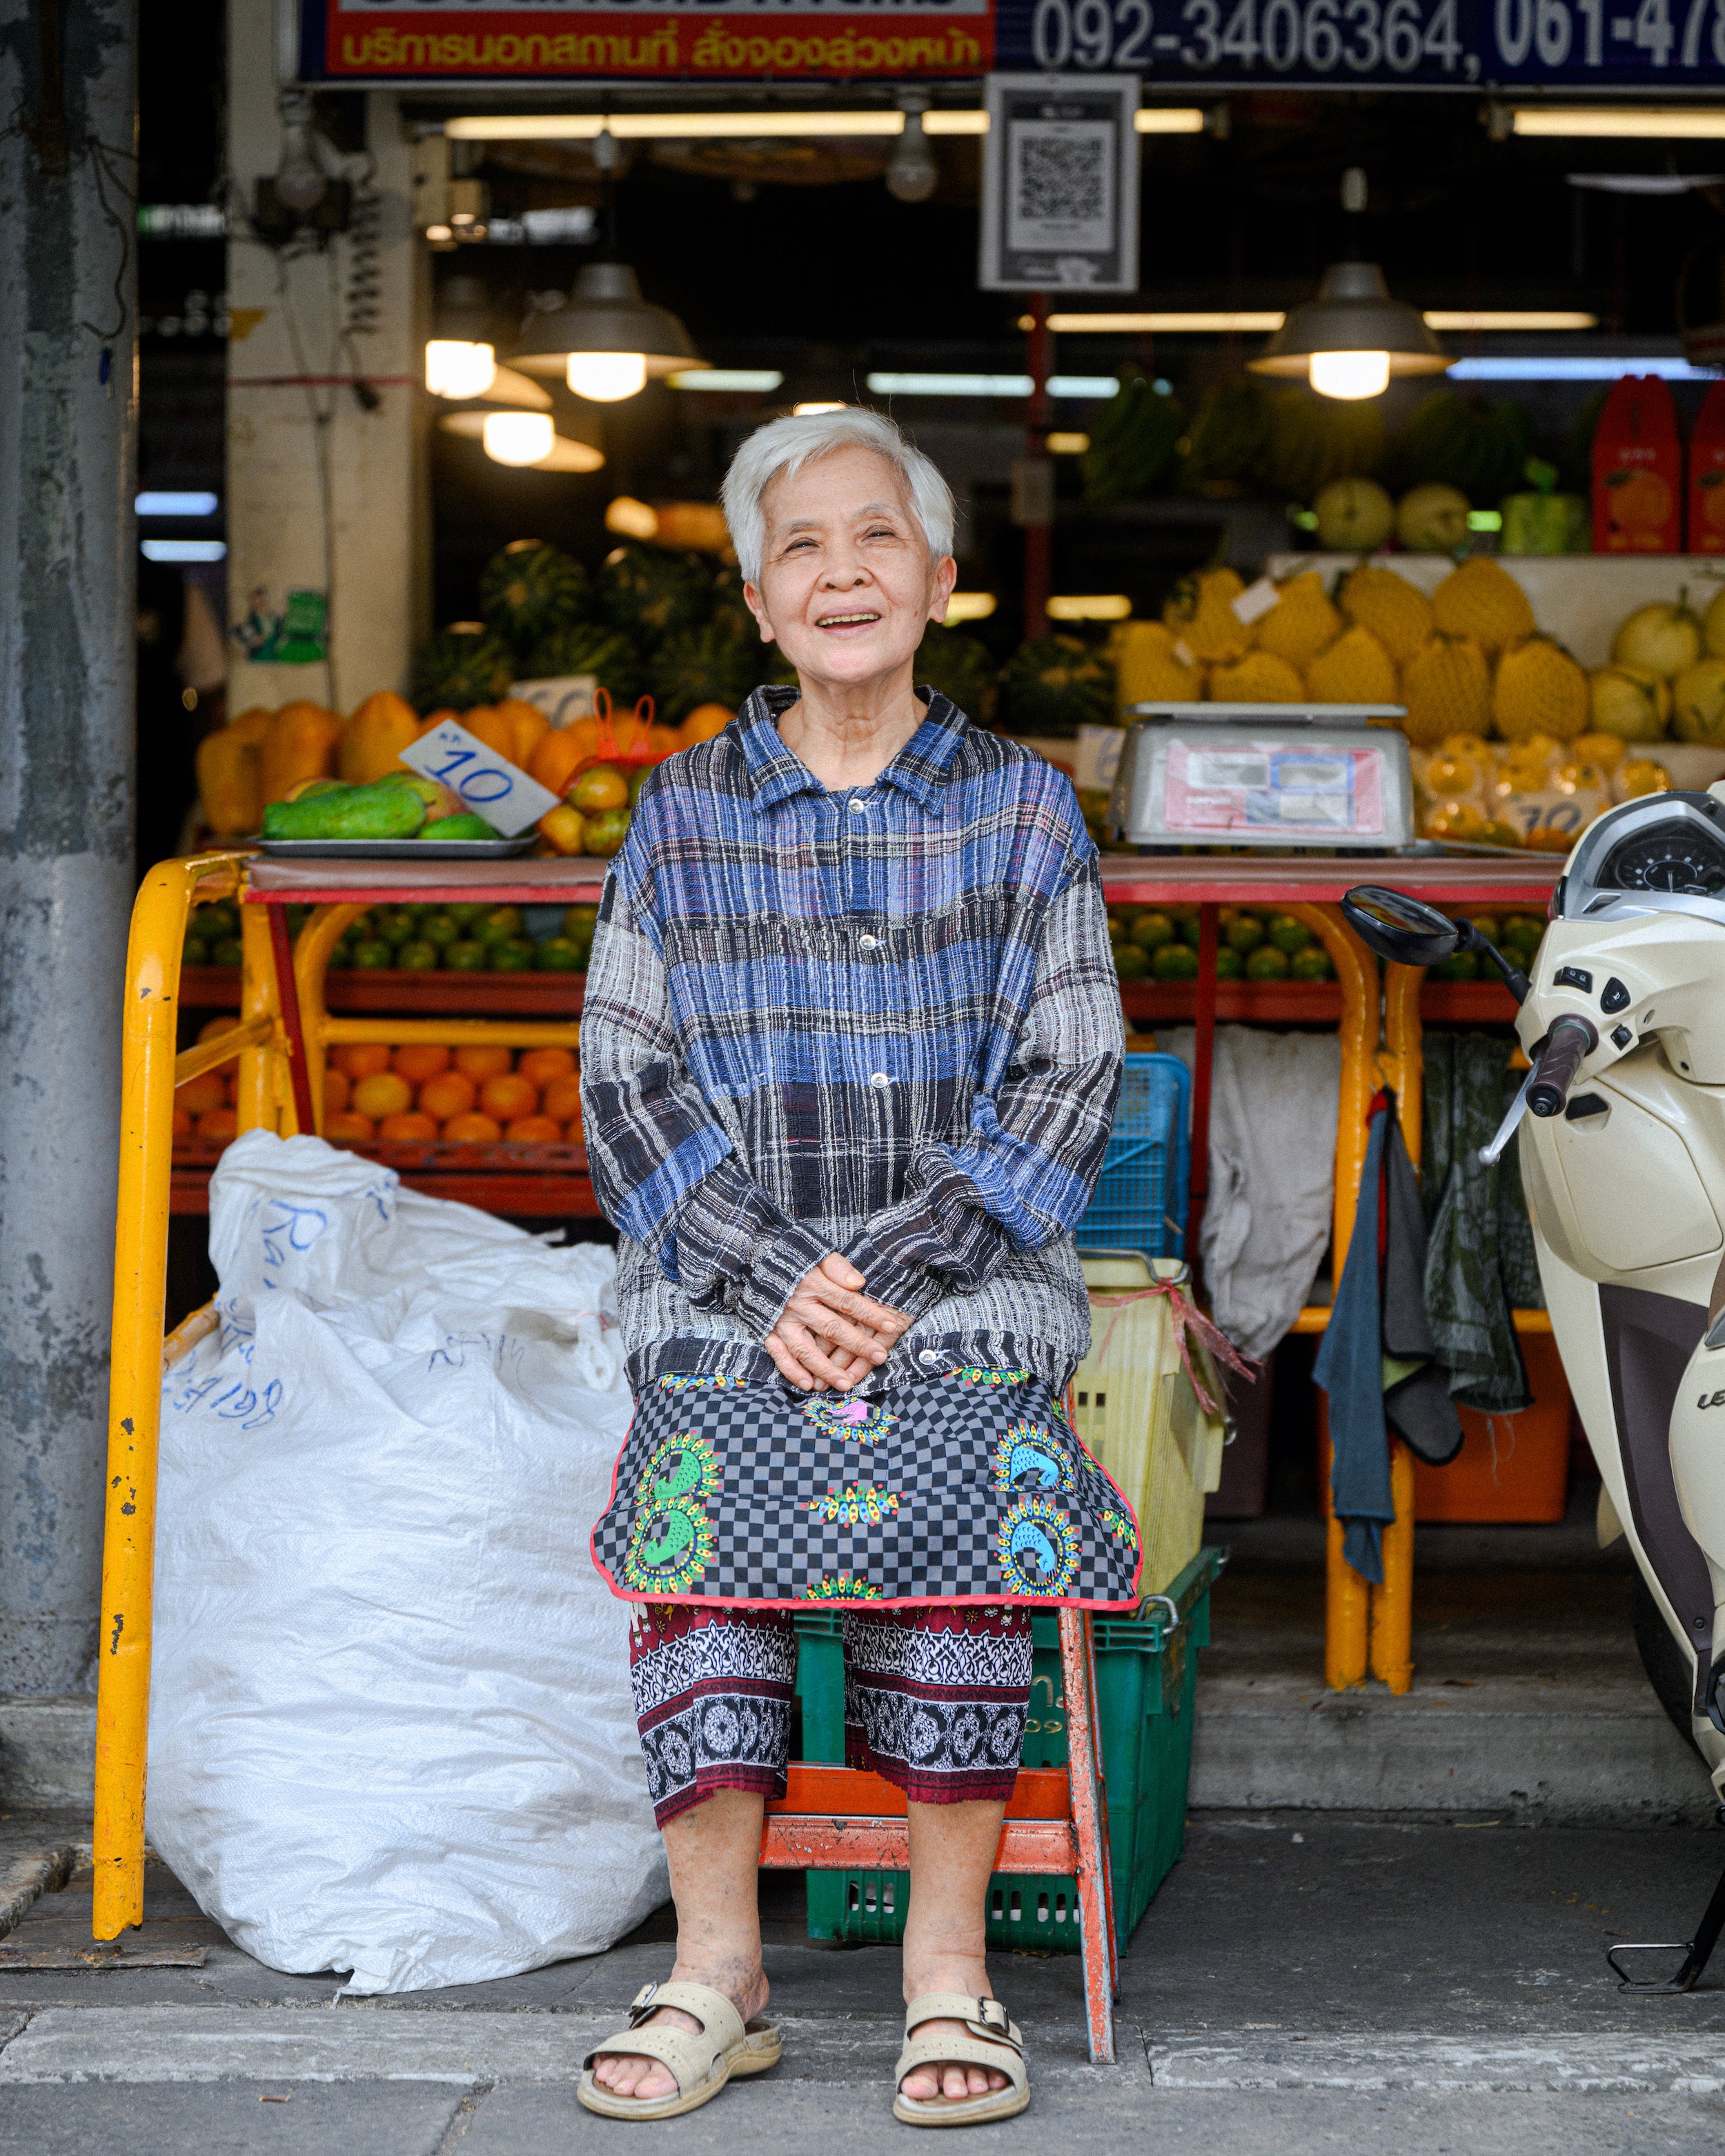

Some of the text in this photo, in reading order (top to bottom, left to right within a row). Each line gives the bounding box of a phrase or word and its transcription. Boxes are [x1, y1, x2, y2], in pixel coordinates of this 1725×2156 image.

[343, 18, 981, 68] บริการนอกสถานที่ สั่งจองล่วงหน้า
[1034, 0, 1481, 82] 092-3406364,
[424, 750, 513, 803] 10
